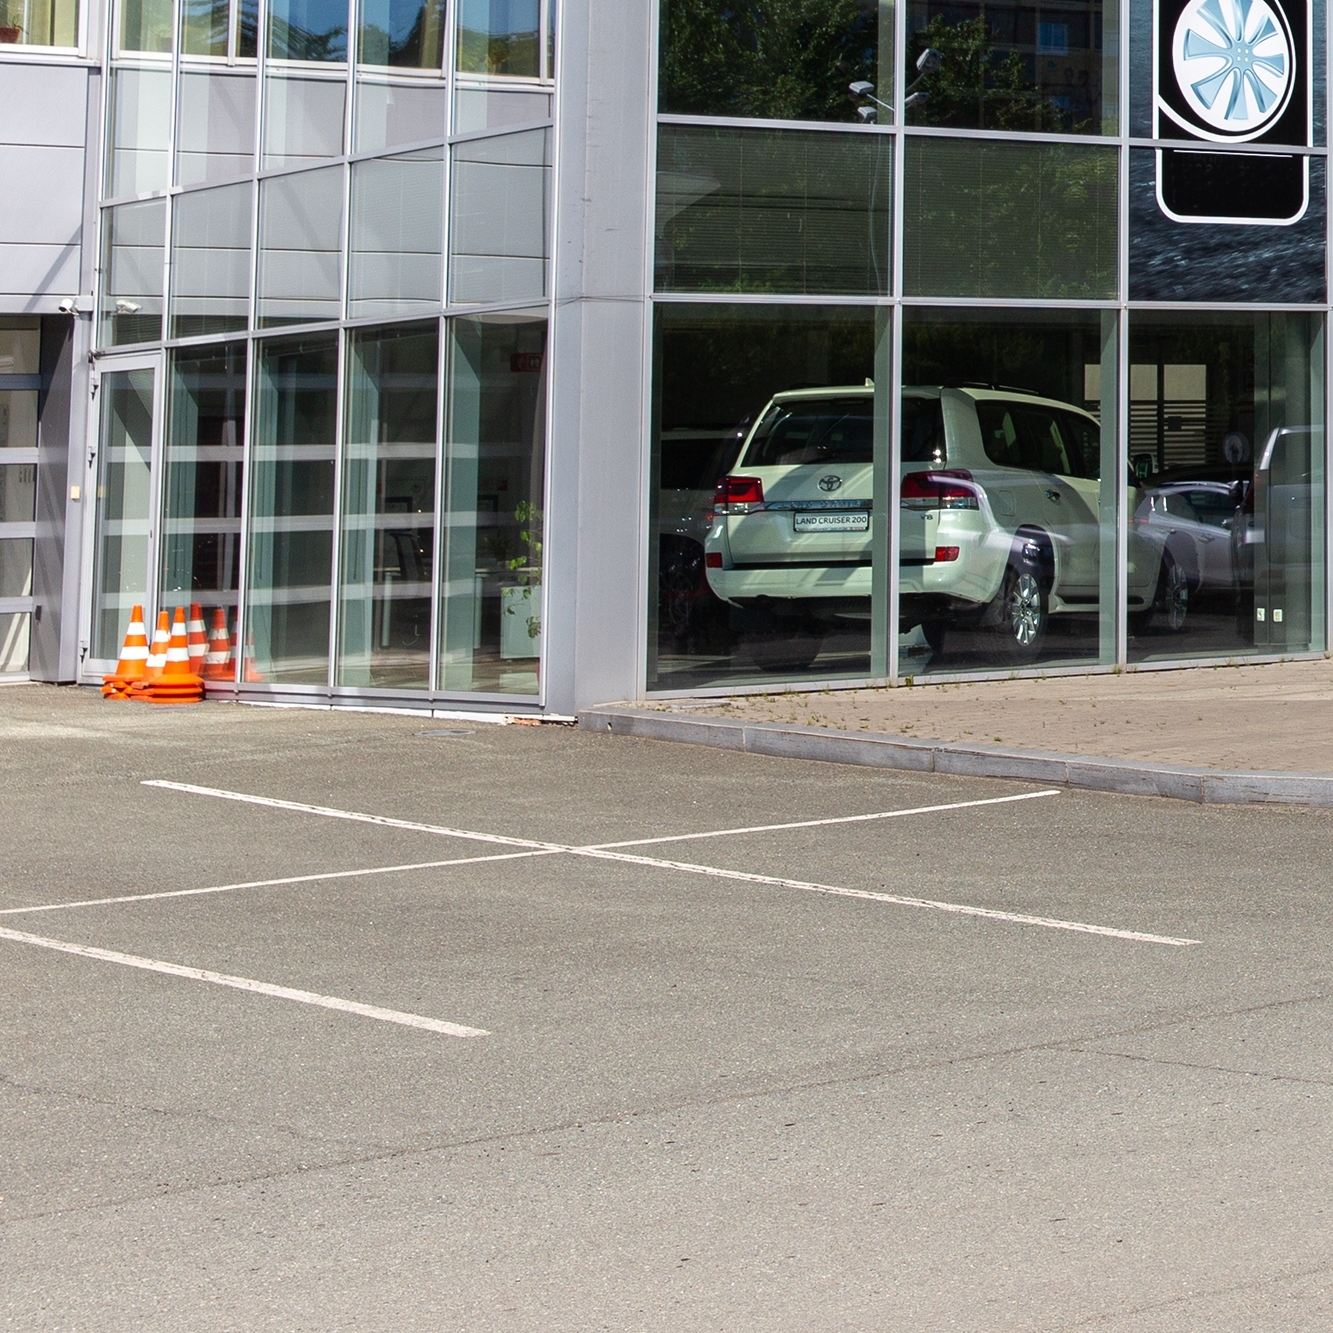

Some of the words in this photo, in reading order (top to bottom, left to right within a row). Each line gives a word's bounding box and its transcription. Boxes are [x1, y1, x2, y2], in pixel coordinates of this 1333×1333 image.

[796, 517, 817, 525] LAND
[818, 516, 850, 524] CRUISER
[852, 516, 867, 524] 200
